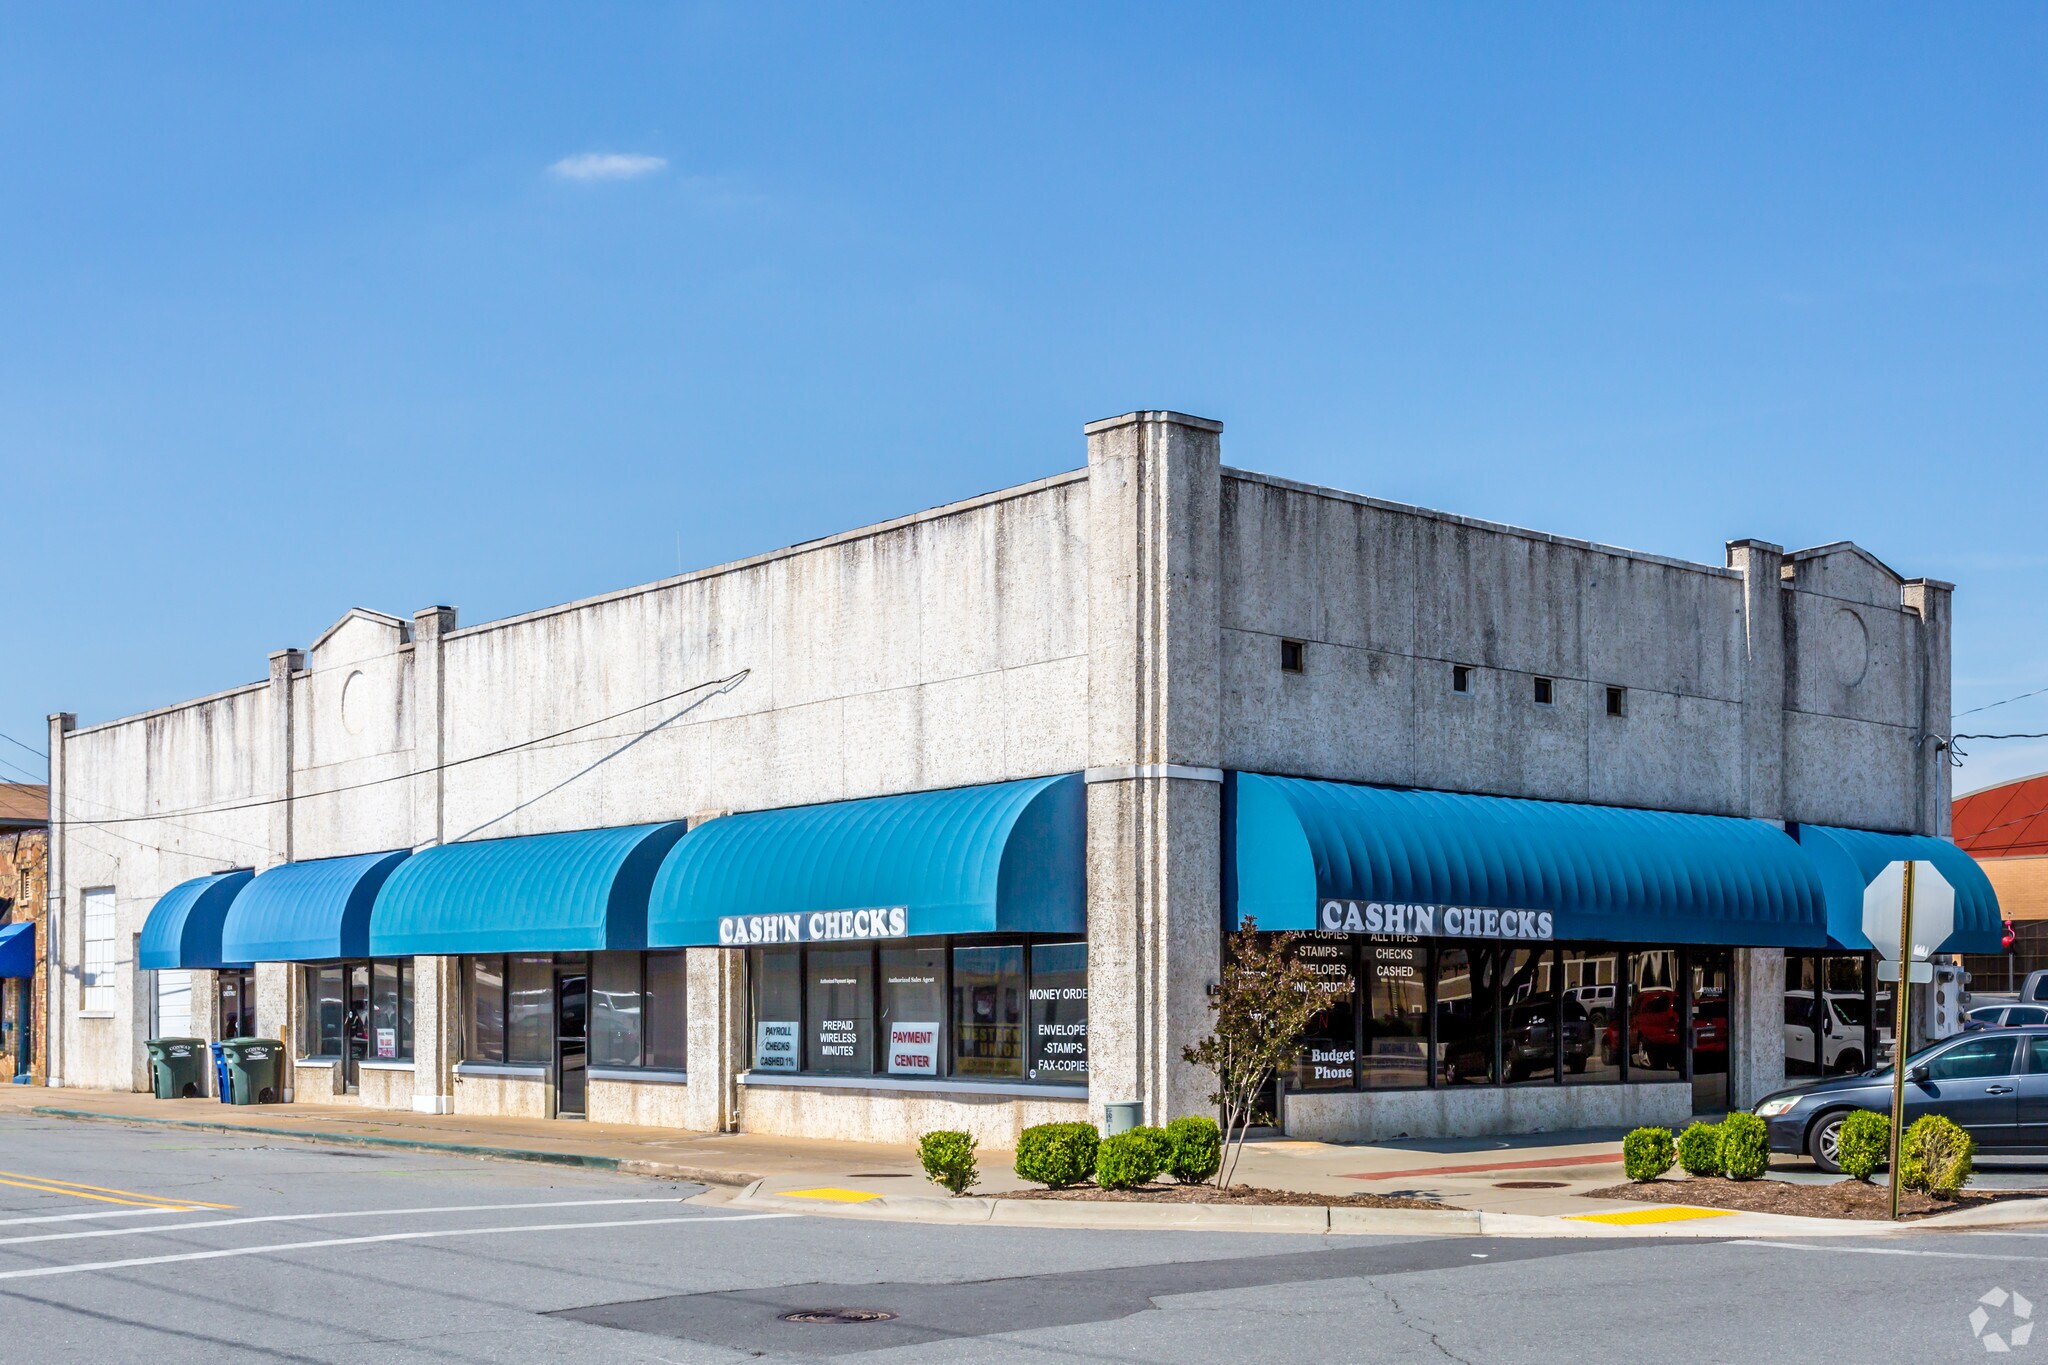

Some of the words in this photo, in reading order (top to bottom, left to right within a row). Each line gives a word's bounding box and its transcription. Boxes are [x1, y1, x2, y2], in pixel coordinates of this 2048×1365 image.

[719, 914, 801, 944] CASH'N
[808, 908, 905, 940] CHECKS
[1322, 901, 1435, 933] CASH'N
[1443, 906, 1553, 939] CHECKS
[1290, 930, 1307, 939] AX
[1314, 930, 1349, 940] COPIES
[1370, 933, 1389, 942] ALL
[1391, 933, 1419, 943] TYPES
[1300, 945, 1338, 957] STAMPS
[1375, 948, 1413, 960] CHECKS
[1302, 964, 1347, 975] ELOPES
[1376, 965, 1414, 977] CASHED
[1029, 988, 1061, 1000] MONEY
[1062, 988, 1088, 999] ORDE
[765, 1026, 792, 1036] PAYROLL
[822, 1020, 854, 1031] PREPAID
[820, 1033, 857, 1043] WIRELESS
[892, 1031, 932, 1043] PAYMENT
[960, 1028, 1021, 1041] WESTERN
[765, 1041, 790, 1051] CHECKS
[822, 1045, 854, 1056] MINUTES
[979, 1042, 1021, 1056] UNION
[760, 1056, 784, 1066] CASHED
[785, 1056, 794, 1067] 1%
[894, 1054, 930, 1068] CENTER
[1311, 1049, 1355, 1064] Budget
[1314, 1066, 1353, 1079] Phone
